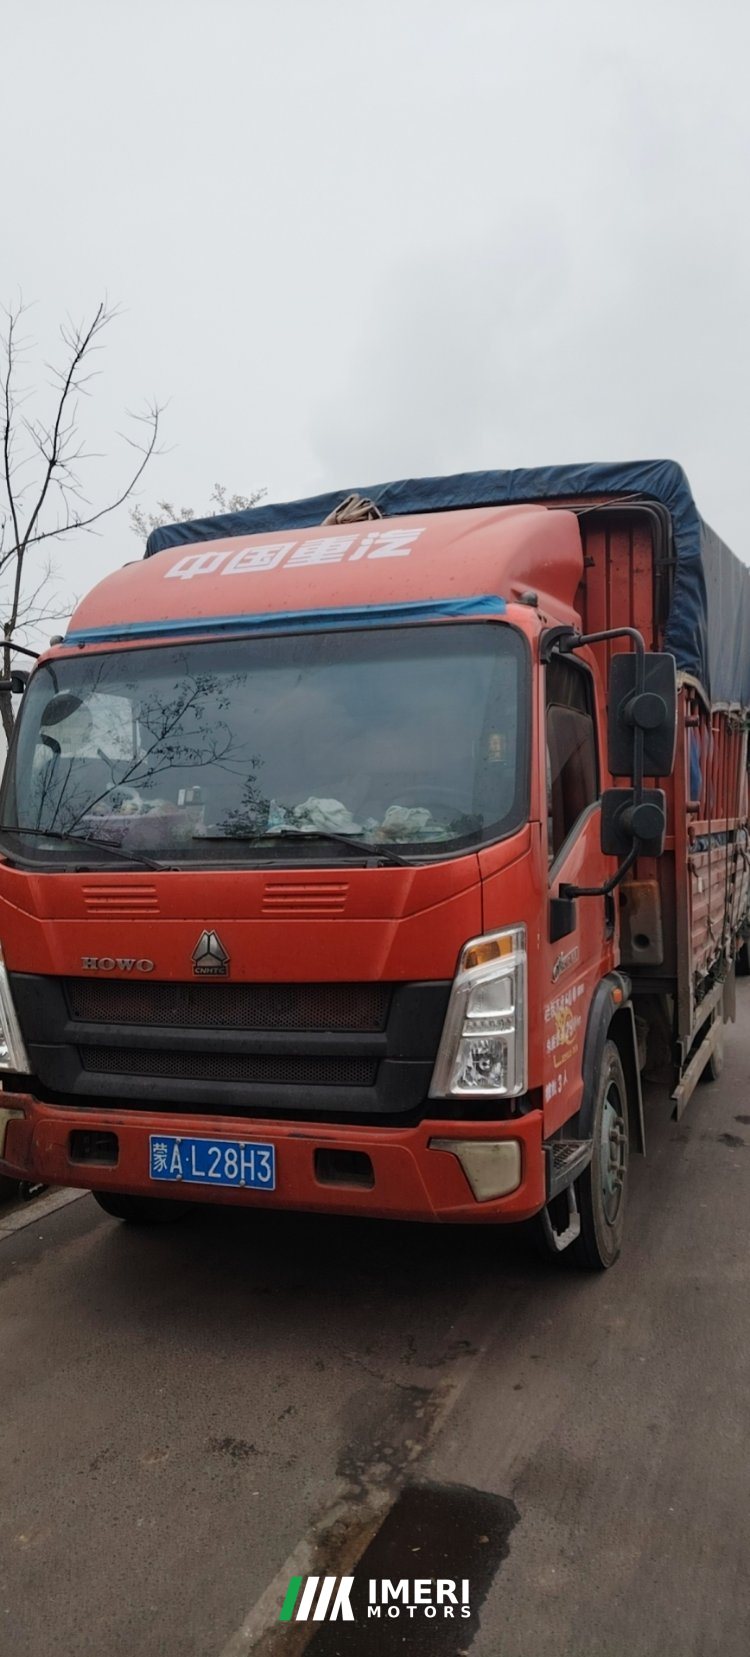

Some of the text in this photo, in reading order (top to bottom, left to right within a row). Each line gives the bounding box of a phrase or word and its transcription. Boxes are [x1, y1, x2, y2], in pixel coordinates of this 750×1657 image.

[164, 527, 426, 580] 中国重汽
[81, 957, 154, 972] HOWO
